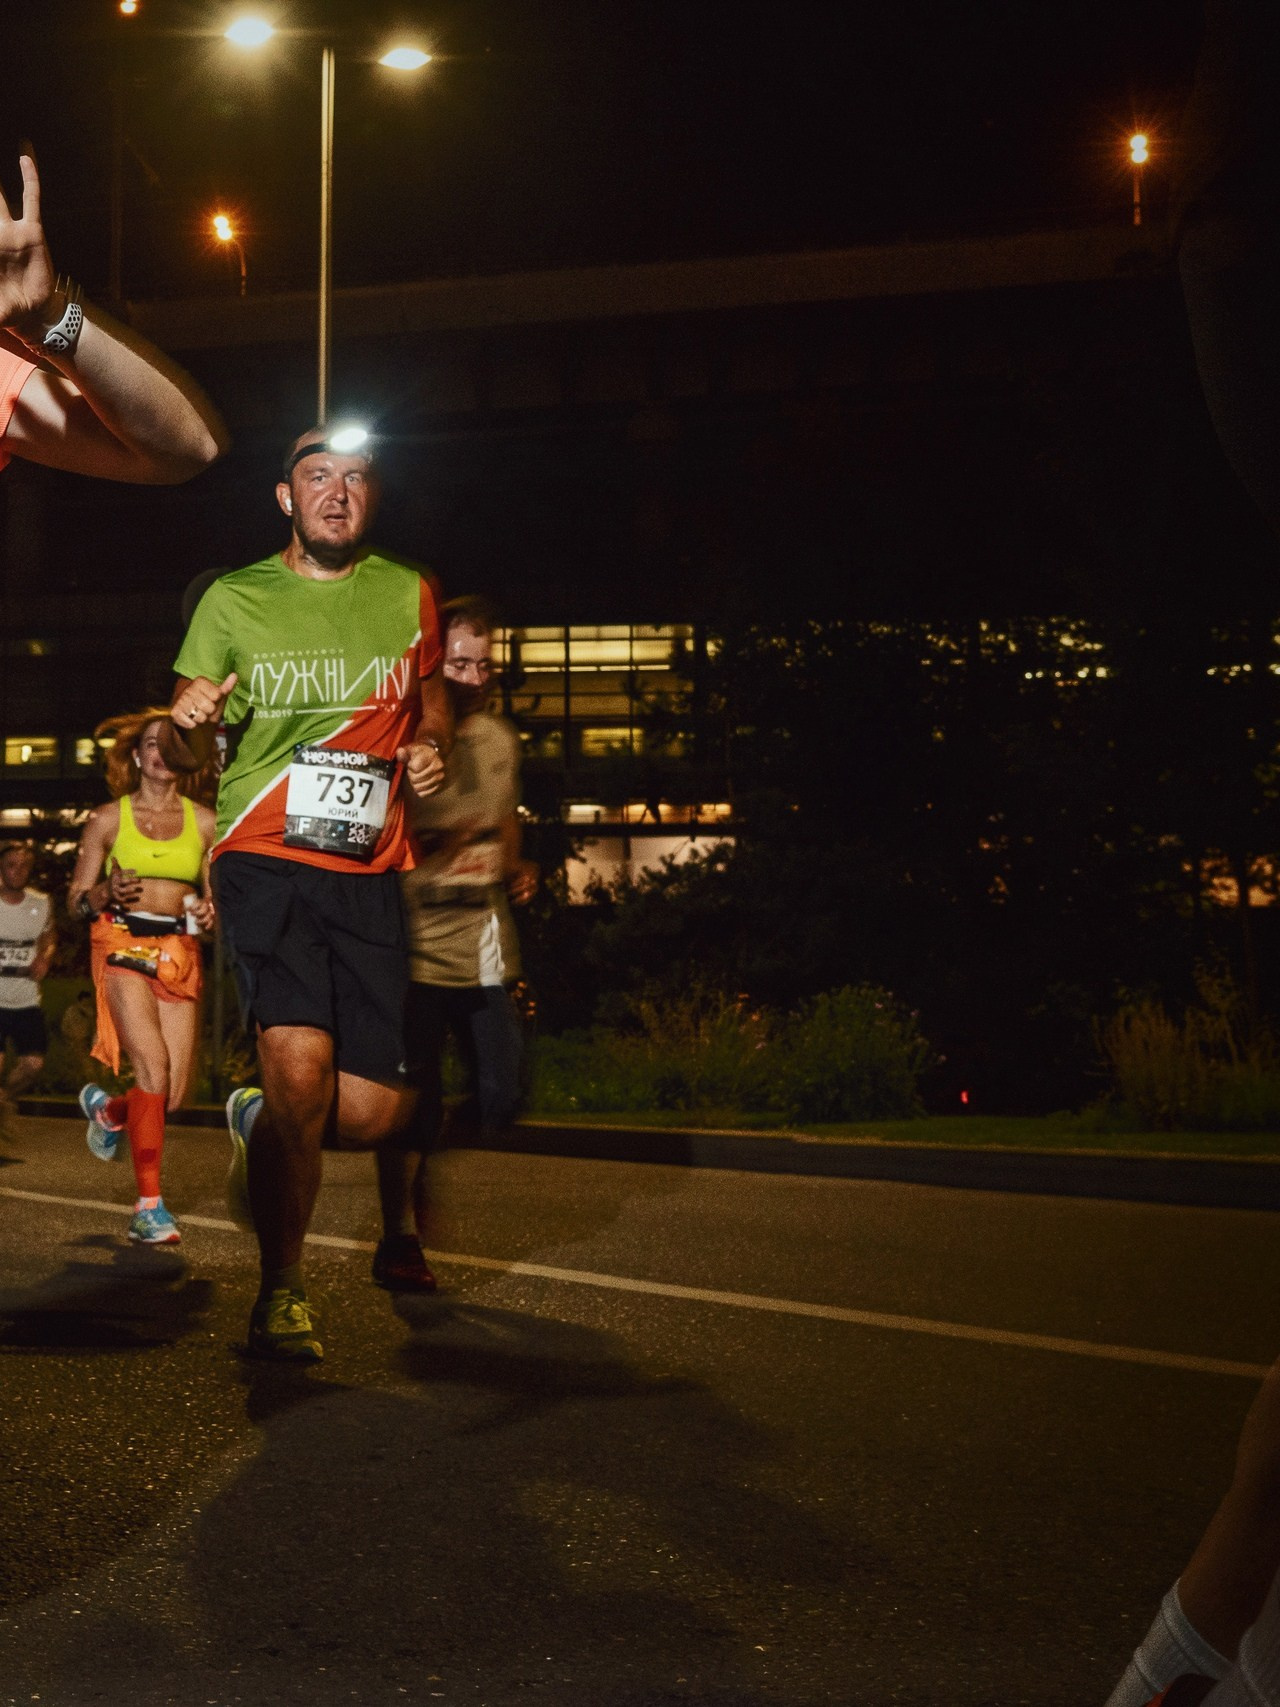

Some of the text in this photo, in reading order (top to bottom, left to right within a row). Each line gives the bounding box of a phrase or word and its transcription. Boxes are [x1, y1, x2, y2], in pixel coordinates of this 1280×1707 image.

[316, 772, 374, 808] 737
[328, 807, 359, 819] ЮРИЙ
[298, 817, 312, 834] F
